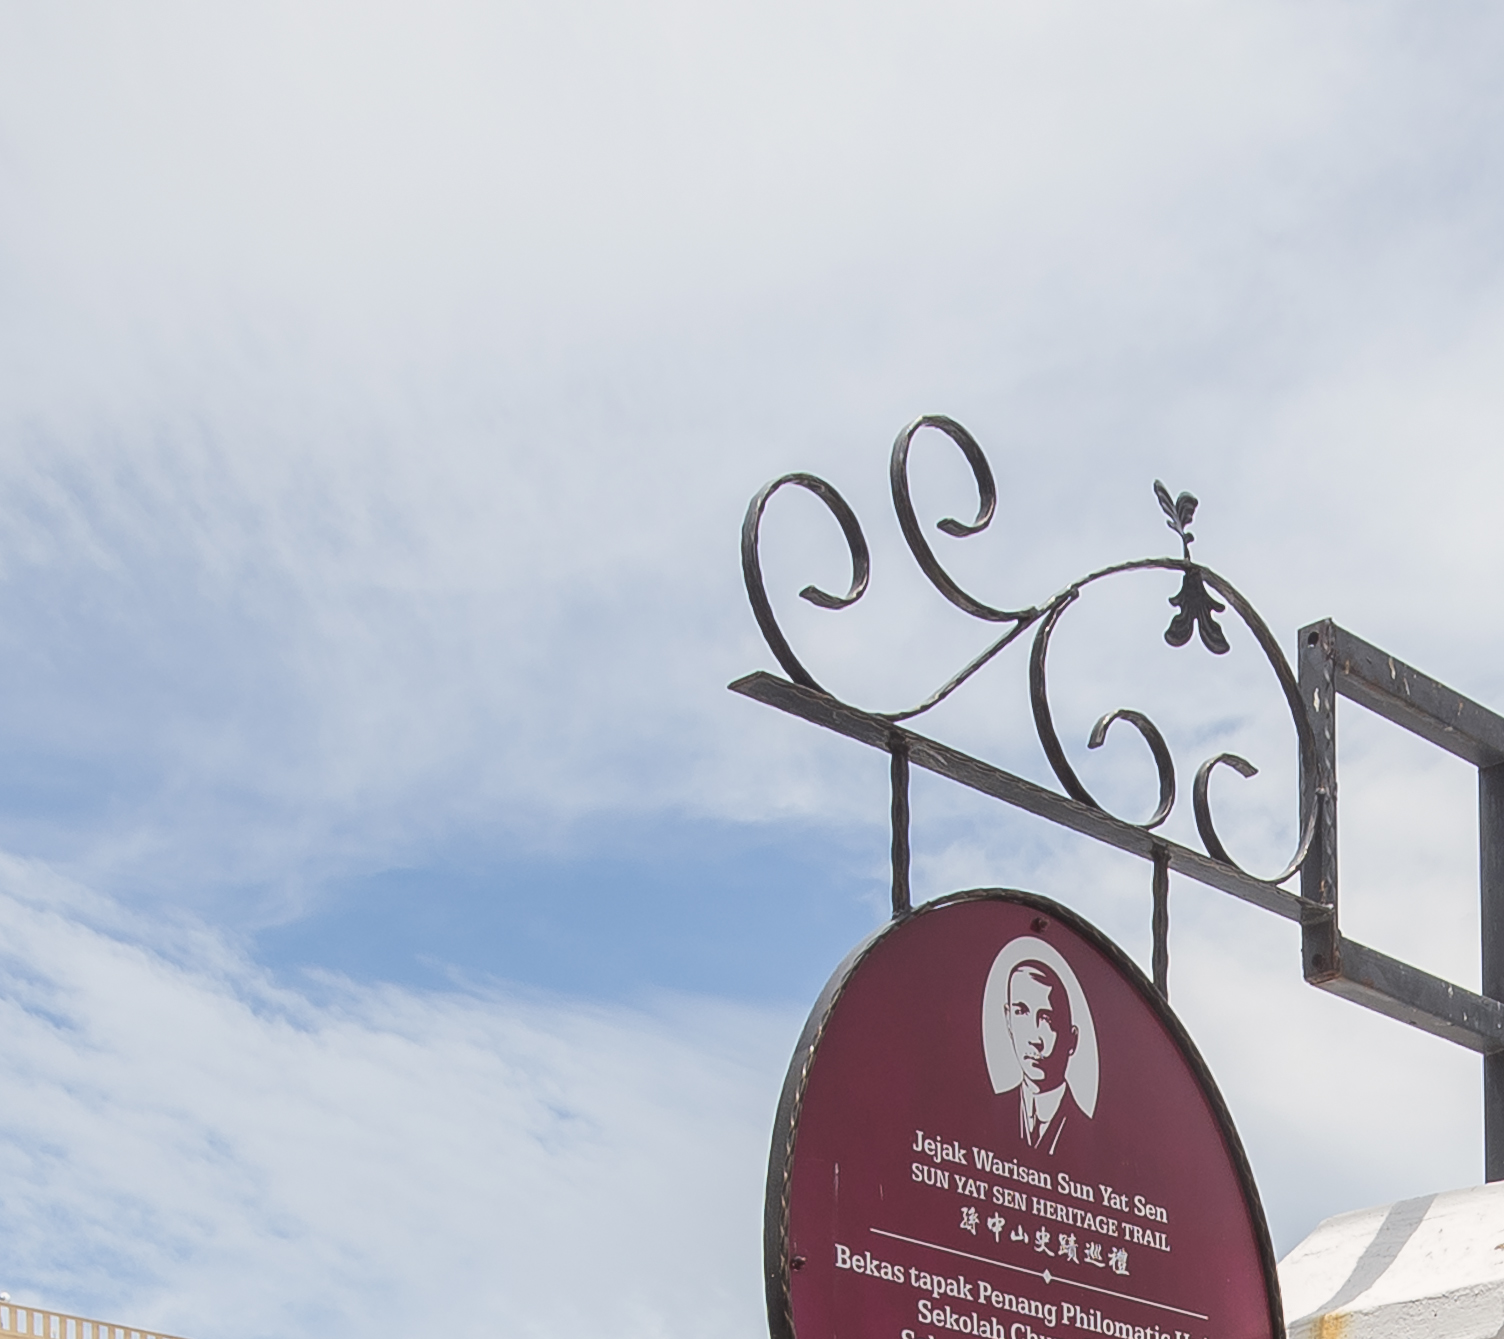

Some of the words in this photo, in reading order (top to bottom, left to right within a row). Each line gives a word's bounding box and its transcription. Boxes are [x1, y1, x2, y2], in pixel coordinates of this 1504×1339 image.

[911, 1163, 950, 1189] SUN
[953, 1174, 988, 1200] YAT
[992, 1185, 1027, 1211] SEN
[1031, 1196, 1118, 1237] HERITAGE
[1121, 1222, 1170, 1252] TRAIL
[912, 1129, 967, 1165] Jejak
[971, 1146, 1052, 1190] Warisan
[1057, 1172, 1094, 1202] Sun
[1098, 1184, 1129, 1212] Yat
[1133, 1195, 1168, 1223] Sen
[834, 1243, 905, 1283] Bekas
[908, 1266, 974, 1301] tapak
[977, 1280, 1057, 1327] Penang
